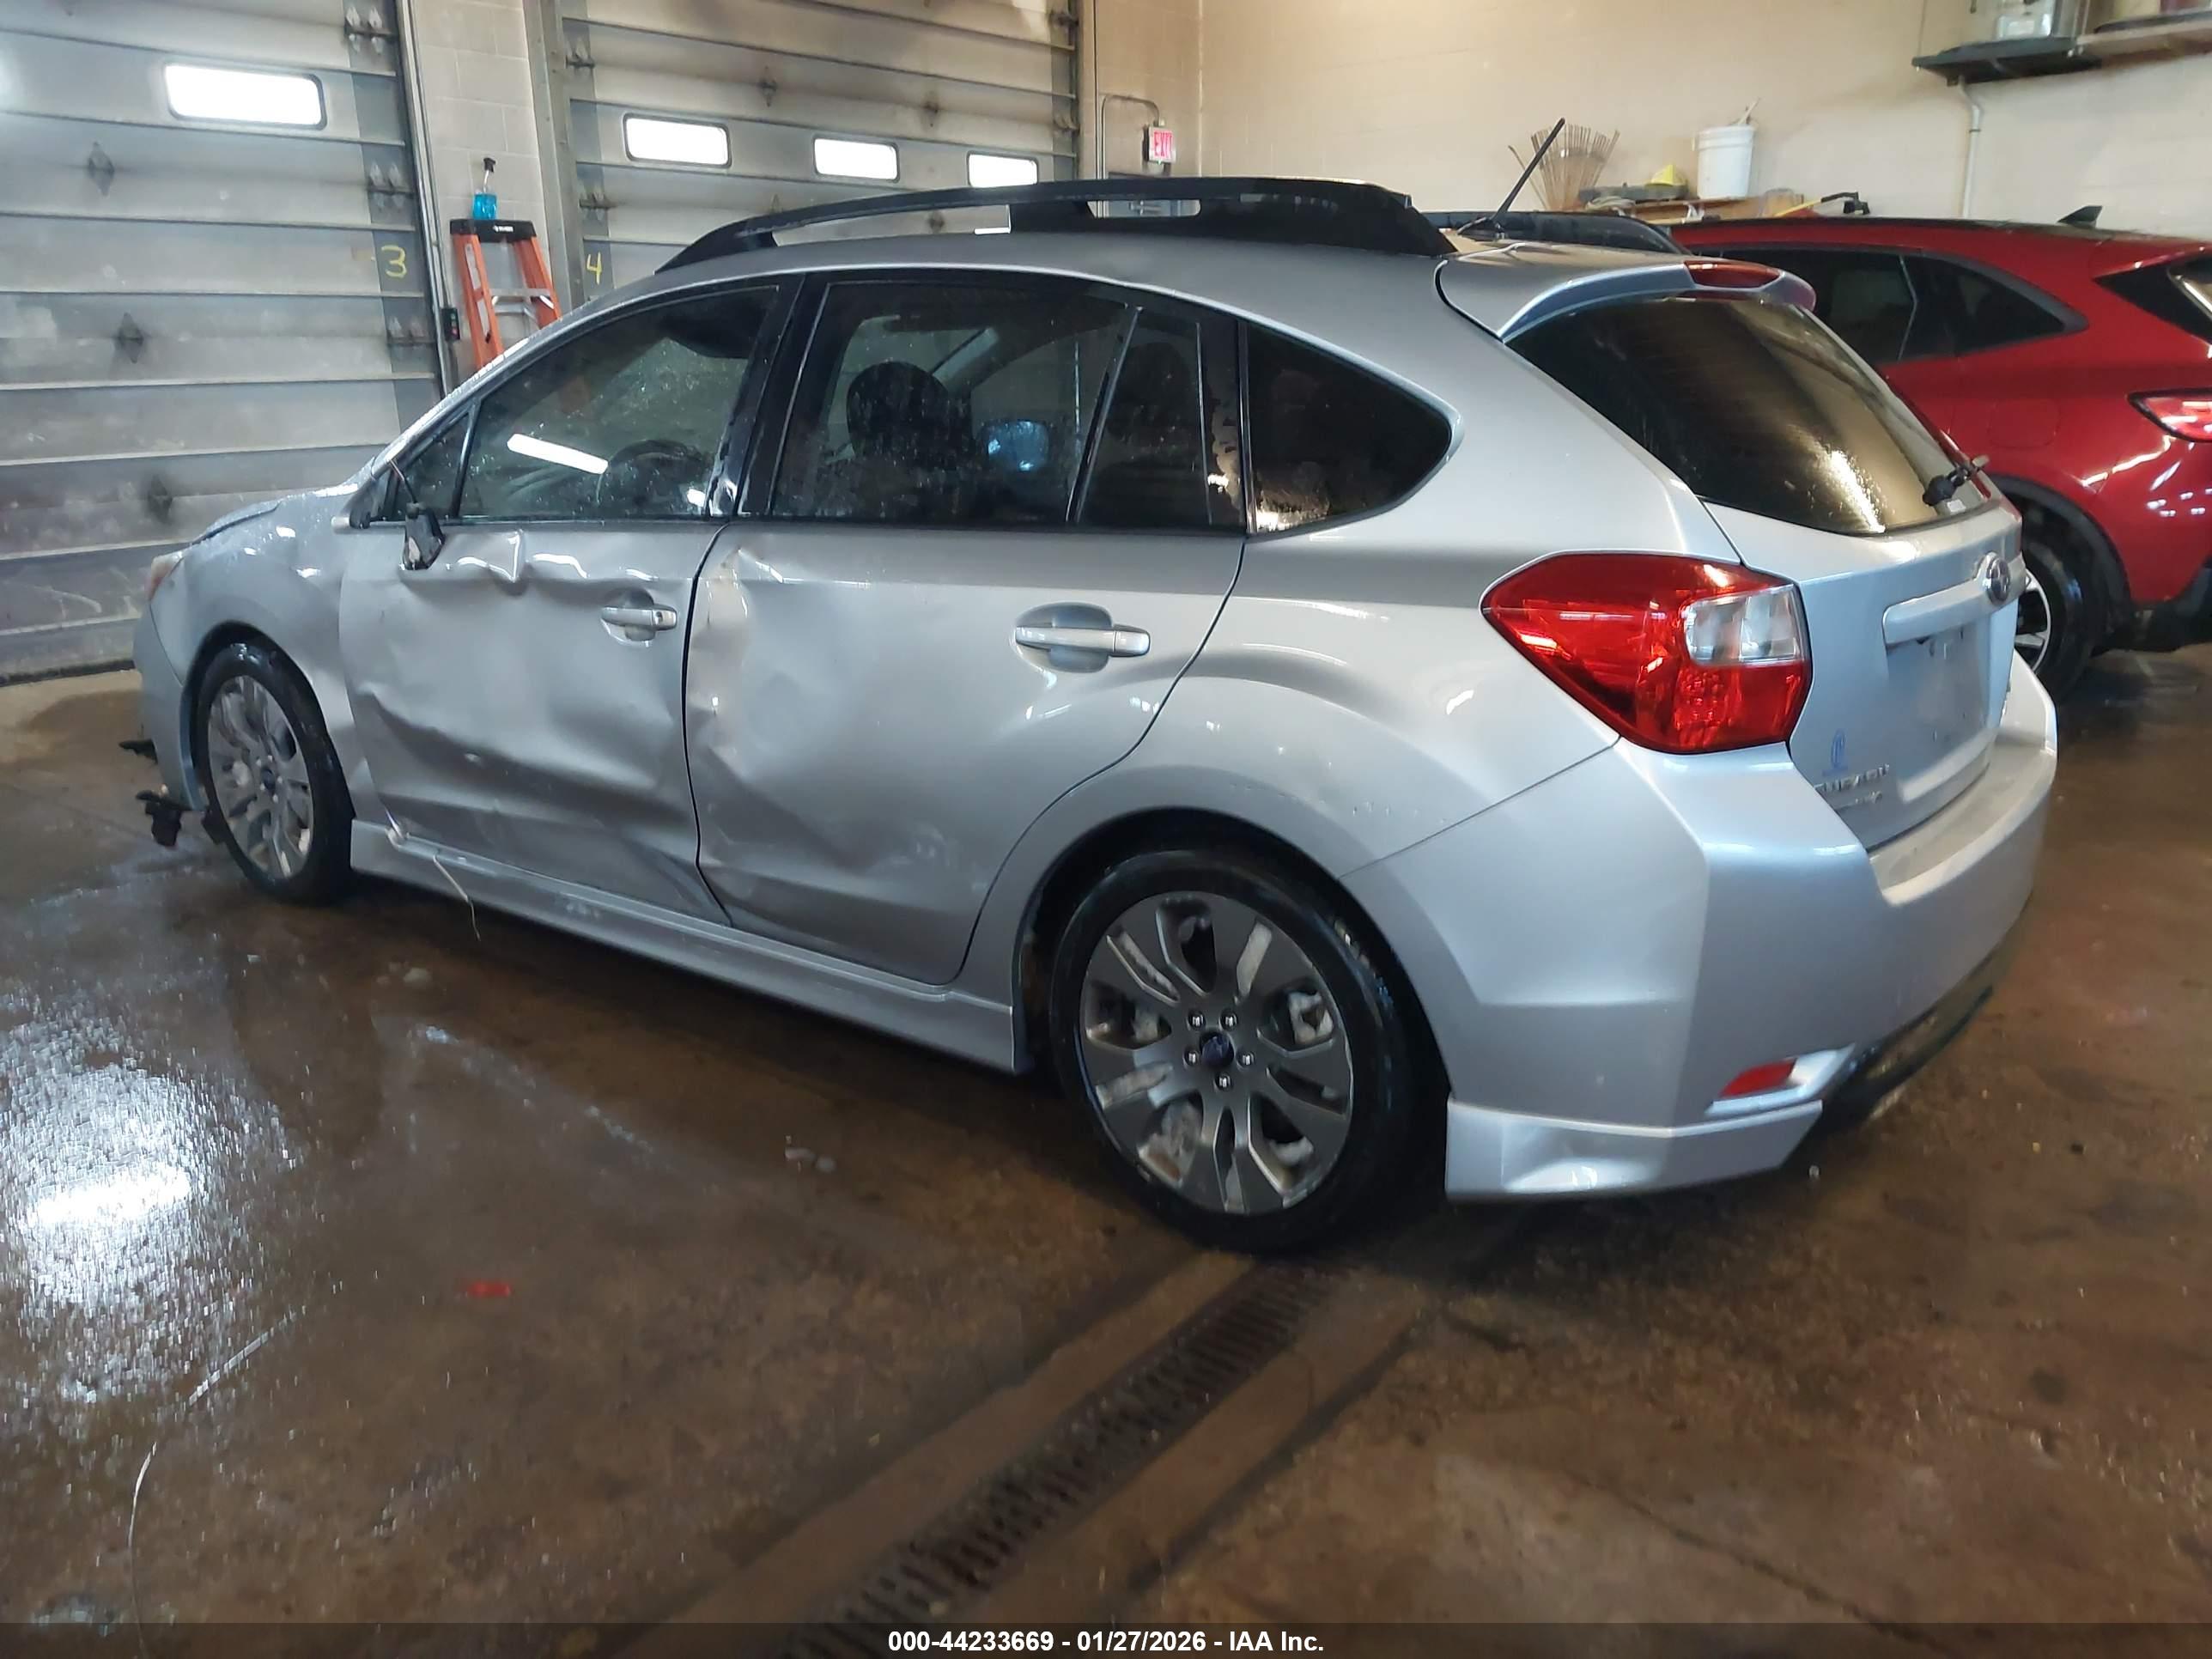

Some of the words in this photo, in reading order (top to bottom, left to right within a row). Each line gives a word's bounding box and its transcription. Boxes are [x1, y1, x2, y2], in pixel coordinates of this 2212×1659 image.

[1153, 131, 1173, 159] EXIT
[381, 245, 407, 278] 3
[586, 251, 602, 285] 4
